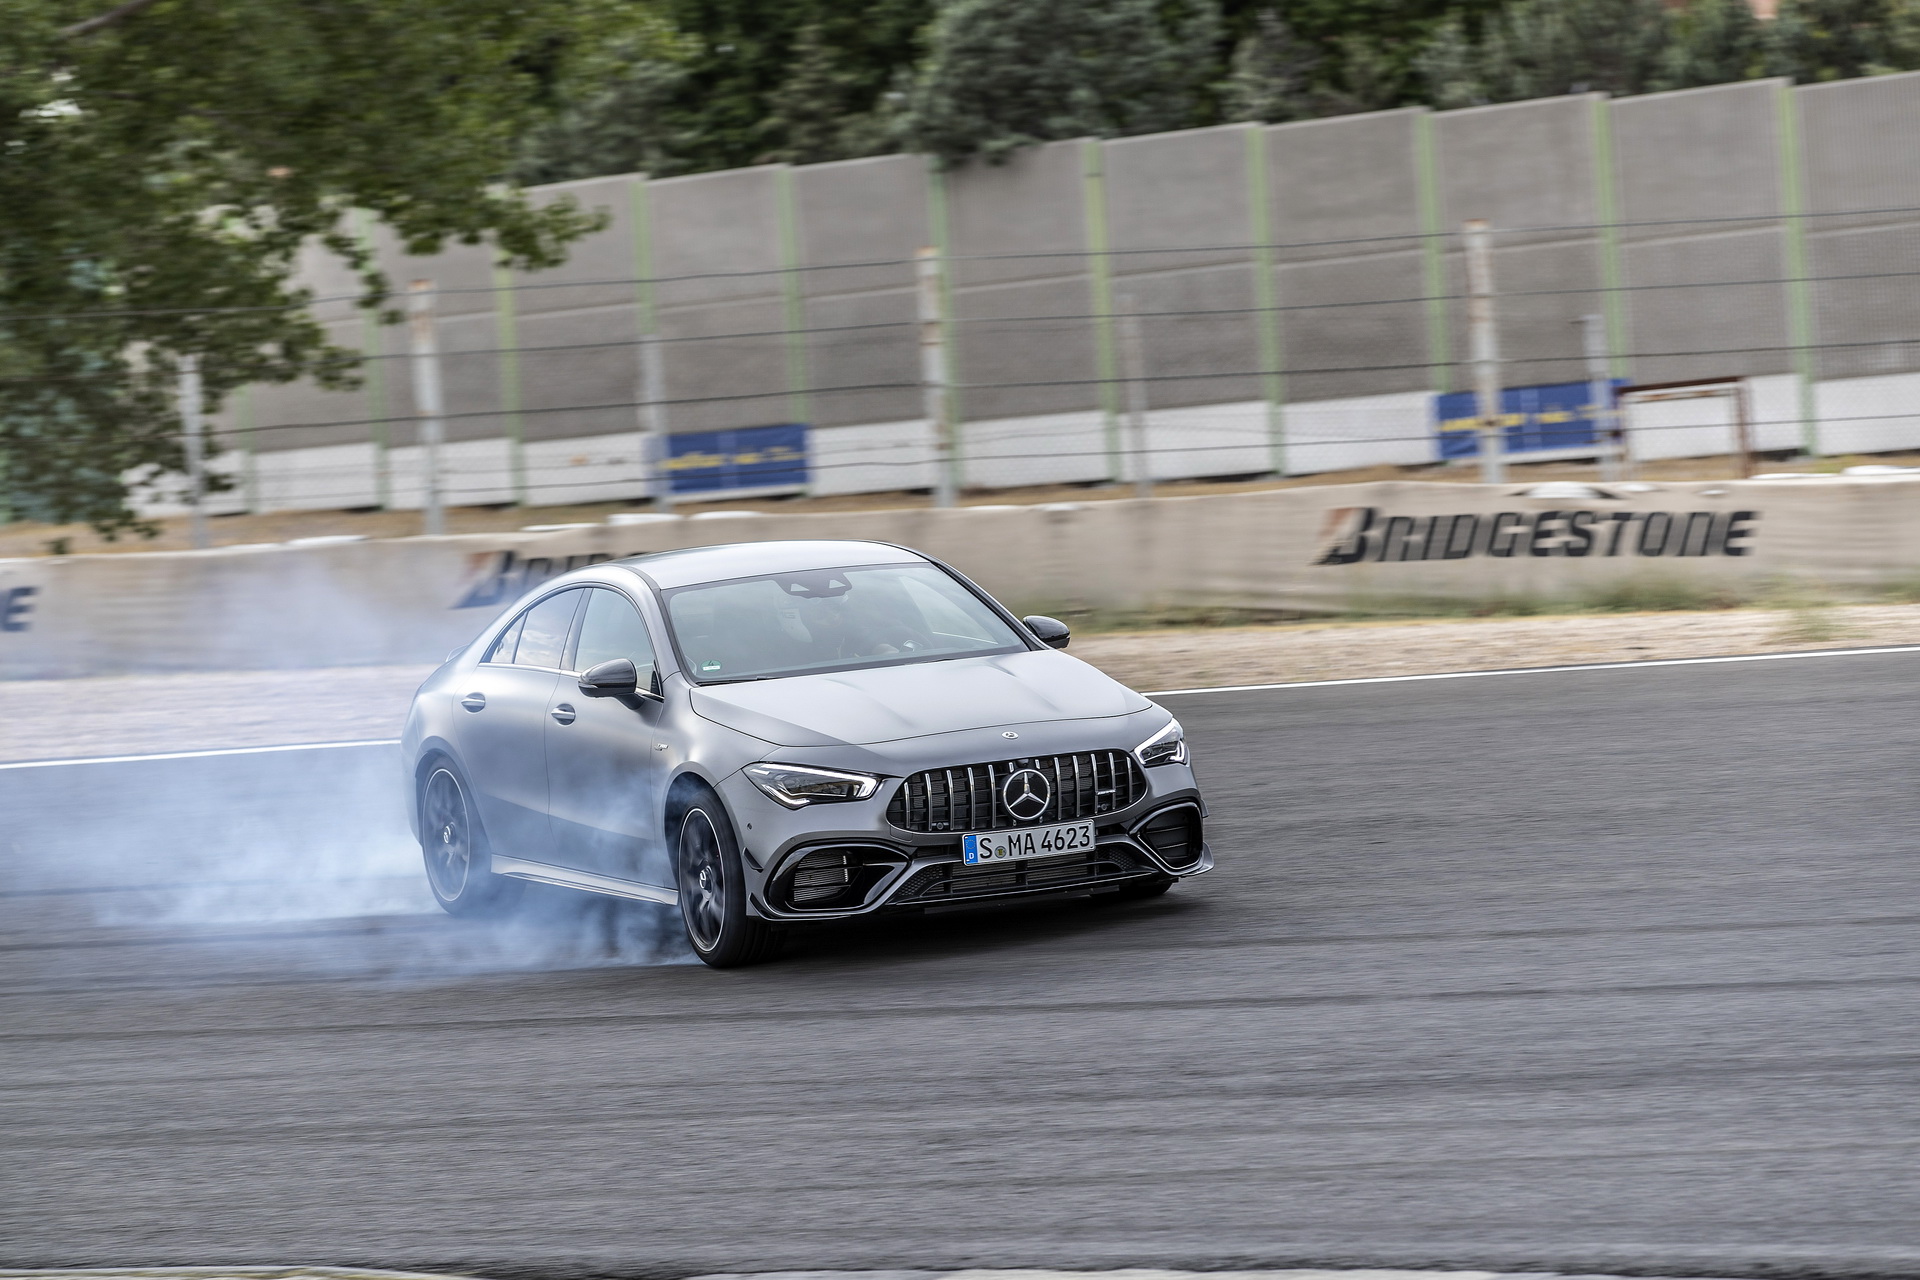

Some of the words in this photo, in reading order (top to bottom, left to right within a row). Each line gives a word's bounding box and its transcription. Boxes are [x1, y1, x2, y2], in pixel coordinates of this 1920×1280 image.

[1311, 507, 1761, 565] BRIDGESTONE
[968, 852, 975, 860] D
[979, 837, 993, 859] S
[1007, 832, 1036, 857] MA
[1040, 825, 1090, 852] 4623
